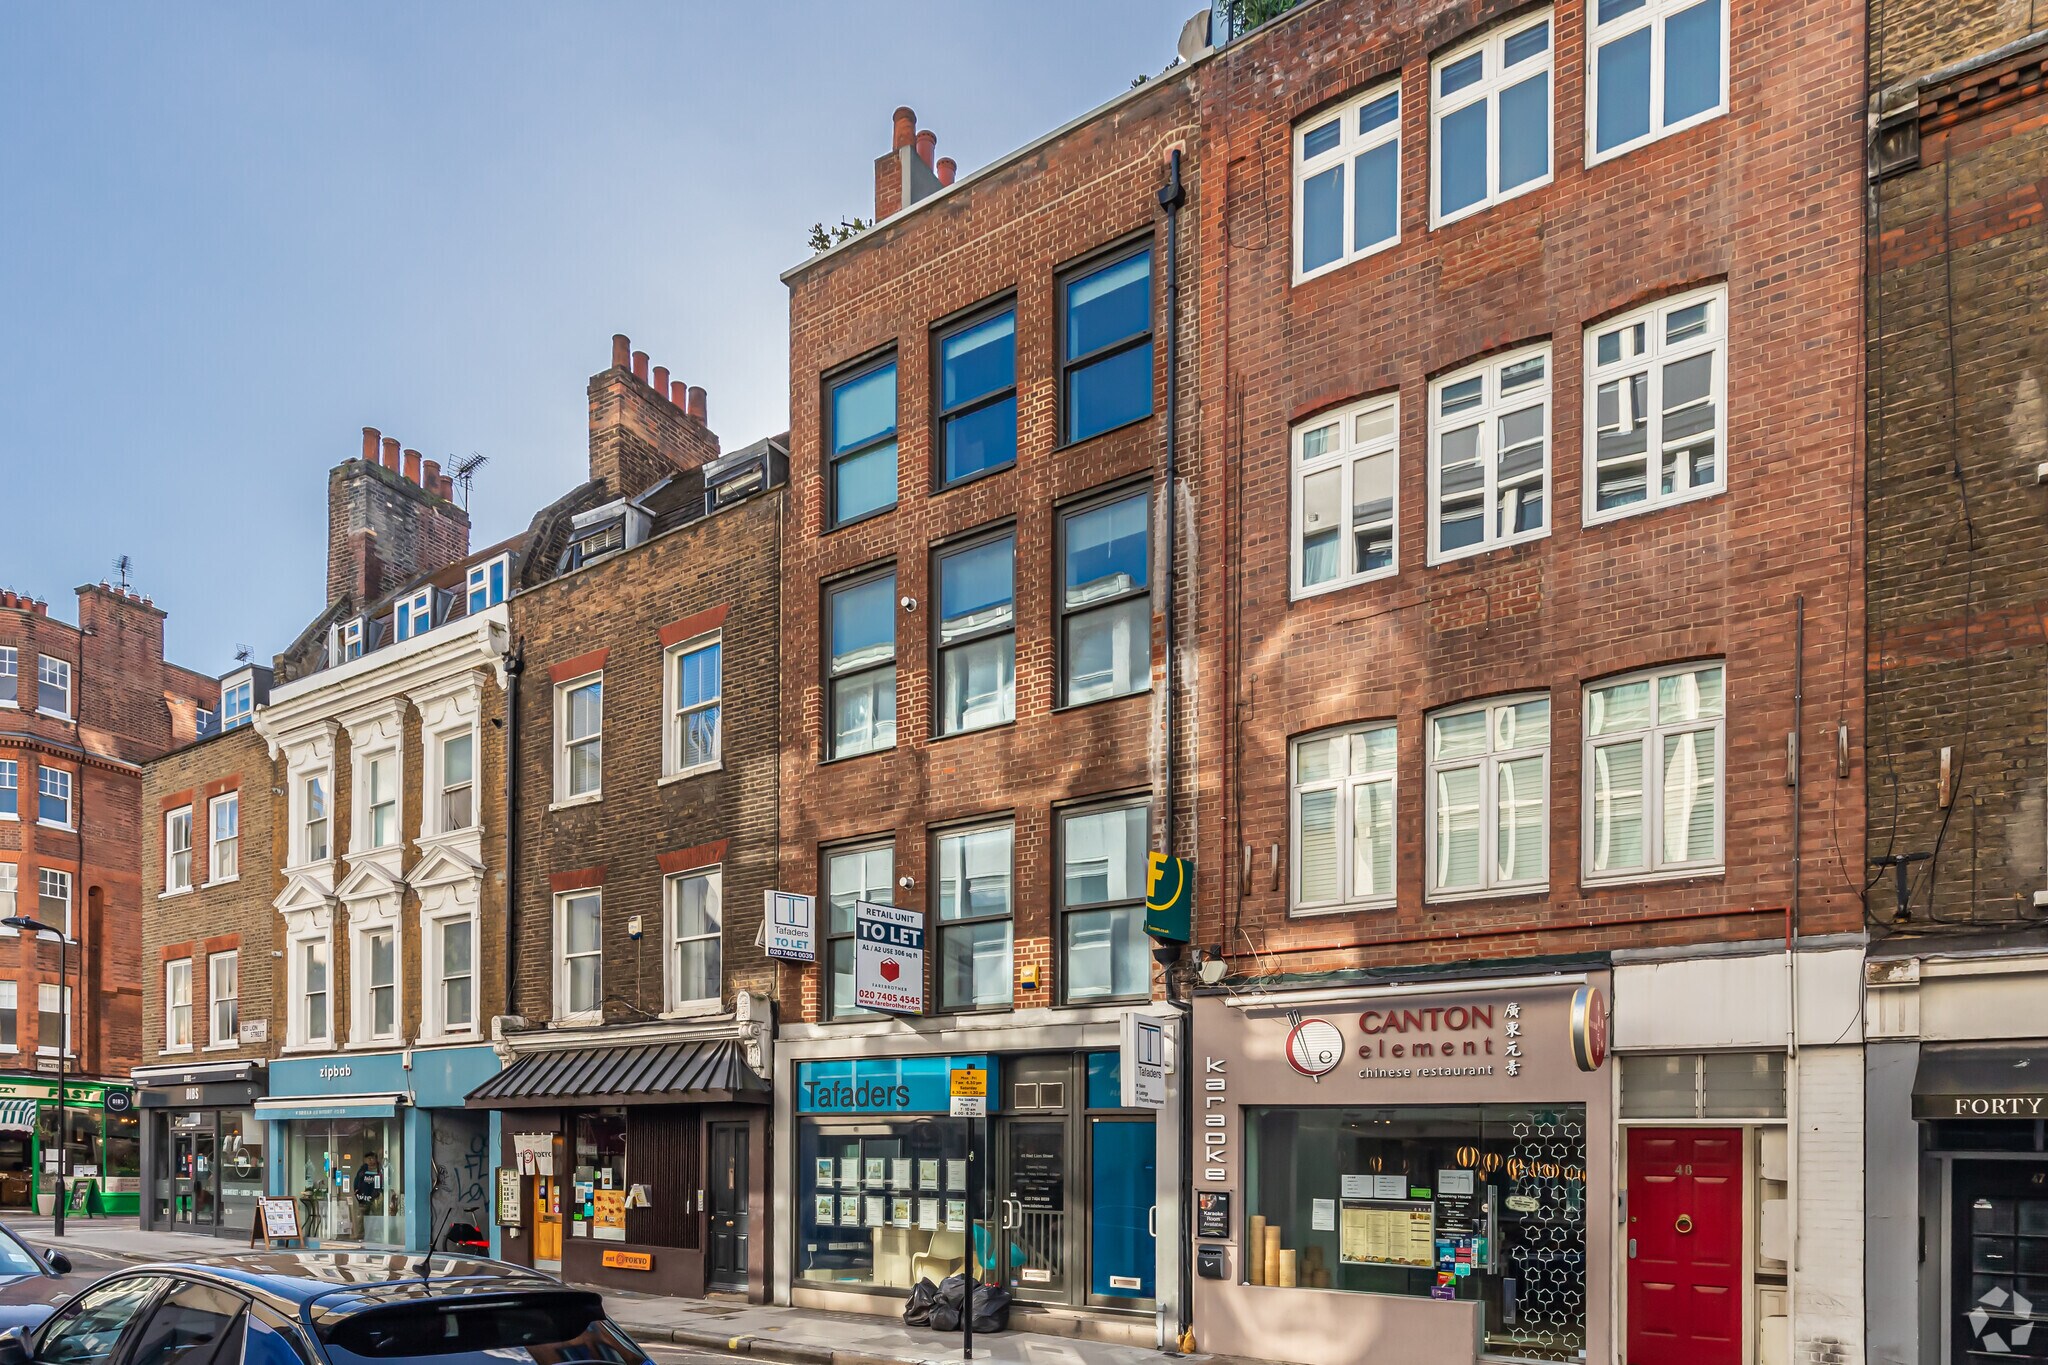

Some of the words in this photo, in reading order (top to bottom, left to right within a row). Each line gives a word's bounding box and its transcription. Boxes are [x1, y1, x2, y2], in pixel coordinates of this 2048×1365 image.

[1147, 851, 1168, 897] F
[866, 908, 893, 920] RETAIL
[895, 913, 915, 923] UNIT
[775, 926, 809, 938] Tafaders
[860, 921, 885, 940] TO
[890, 926, 921, 946] LET
[775, 938, 788, 947] TO
[791, 940, 809, 949] LET
[882, 947, 894, 955] USE
[894, 949, 905, 957] 306
[872, 983, 908, 991] FAREBROTHER
[859, 990, 875, 999] 020
[877, 992, 898, 1002] 7405
[900, 995, 920, 1005] 4545
[859, 999, 921, 1011] www.farebrother.com
[1359, 1004, 1494, 1035] CANTON
[1504, 1002, 1523, 1077] 廣東元素
[1358, 1036, 1493, 1059] element
[319, 1064, 352, 1081] zipbab
[1138, 1066, 1161, 1079] Tafaders
[1358, 1067, 1412, 1079] chinese
[1416, 1065, 1493, 1077] restaurant
[186, 1088, 199, 1100] DIBS
[804, 1080, 910, 1108] Tafaders
[1954, 1097, 2045, 1115] FORTY
[1674, 1164, 1693, 1176] 48
[2031, 1173, 2046, 1184] 47
[624, 1256, 648, 1265] TOKYO
